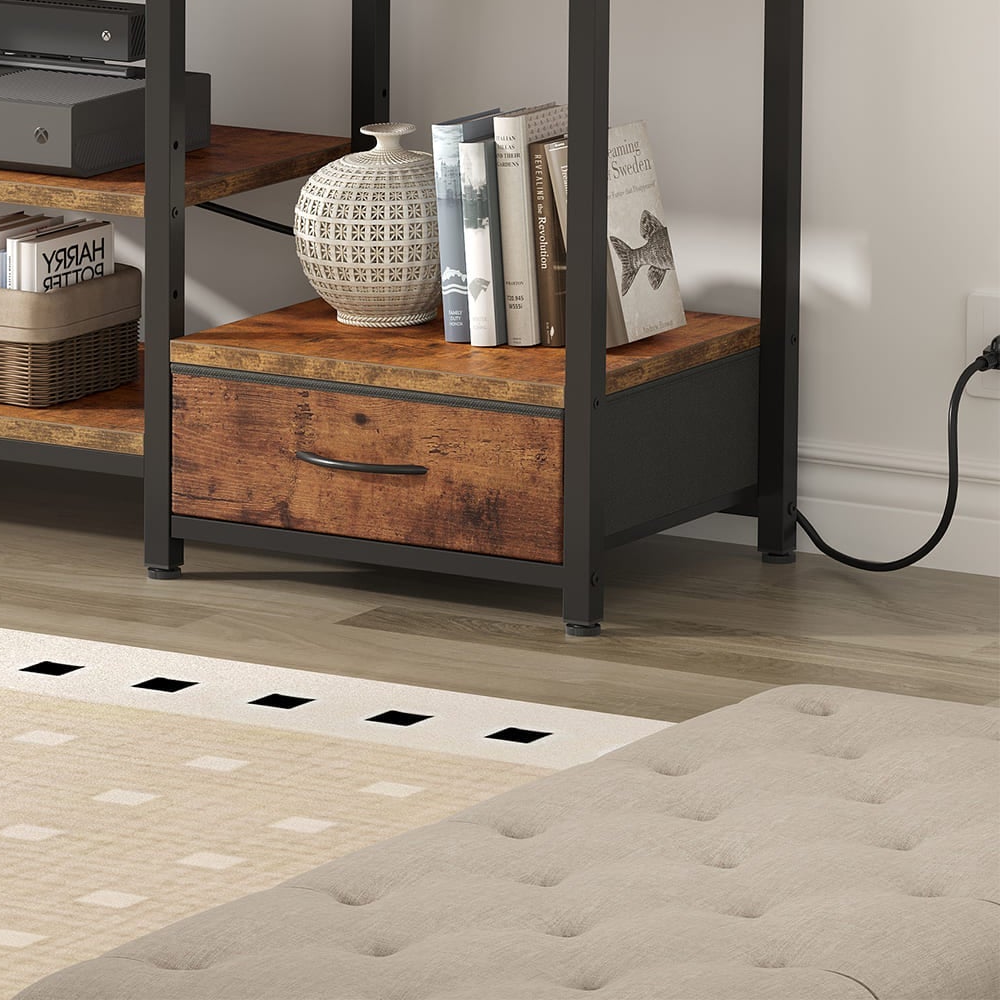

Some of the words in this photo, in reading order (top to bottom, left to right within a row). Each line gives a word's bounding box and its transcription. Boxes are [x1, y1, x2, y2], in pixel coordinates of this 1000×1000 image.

[608, 139, 640, 158] eaming
[534, 154, 545, 201] REVEALING
[611, 155, 652, 179] Sweden
[538, 216, 549, 270] Revolution
